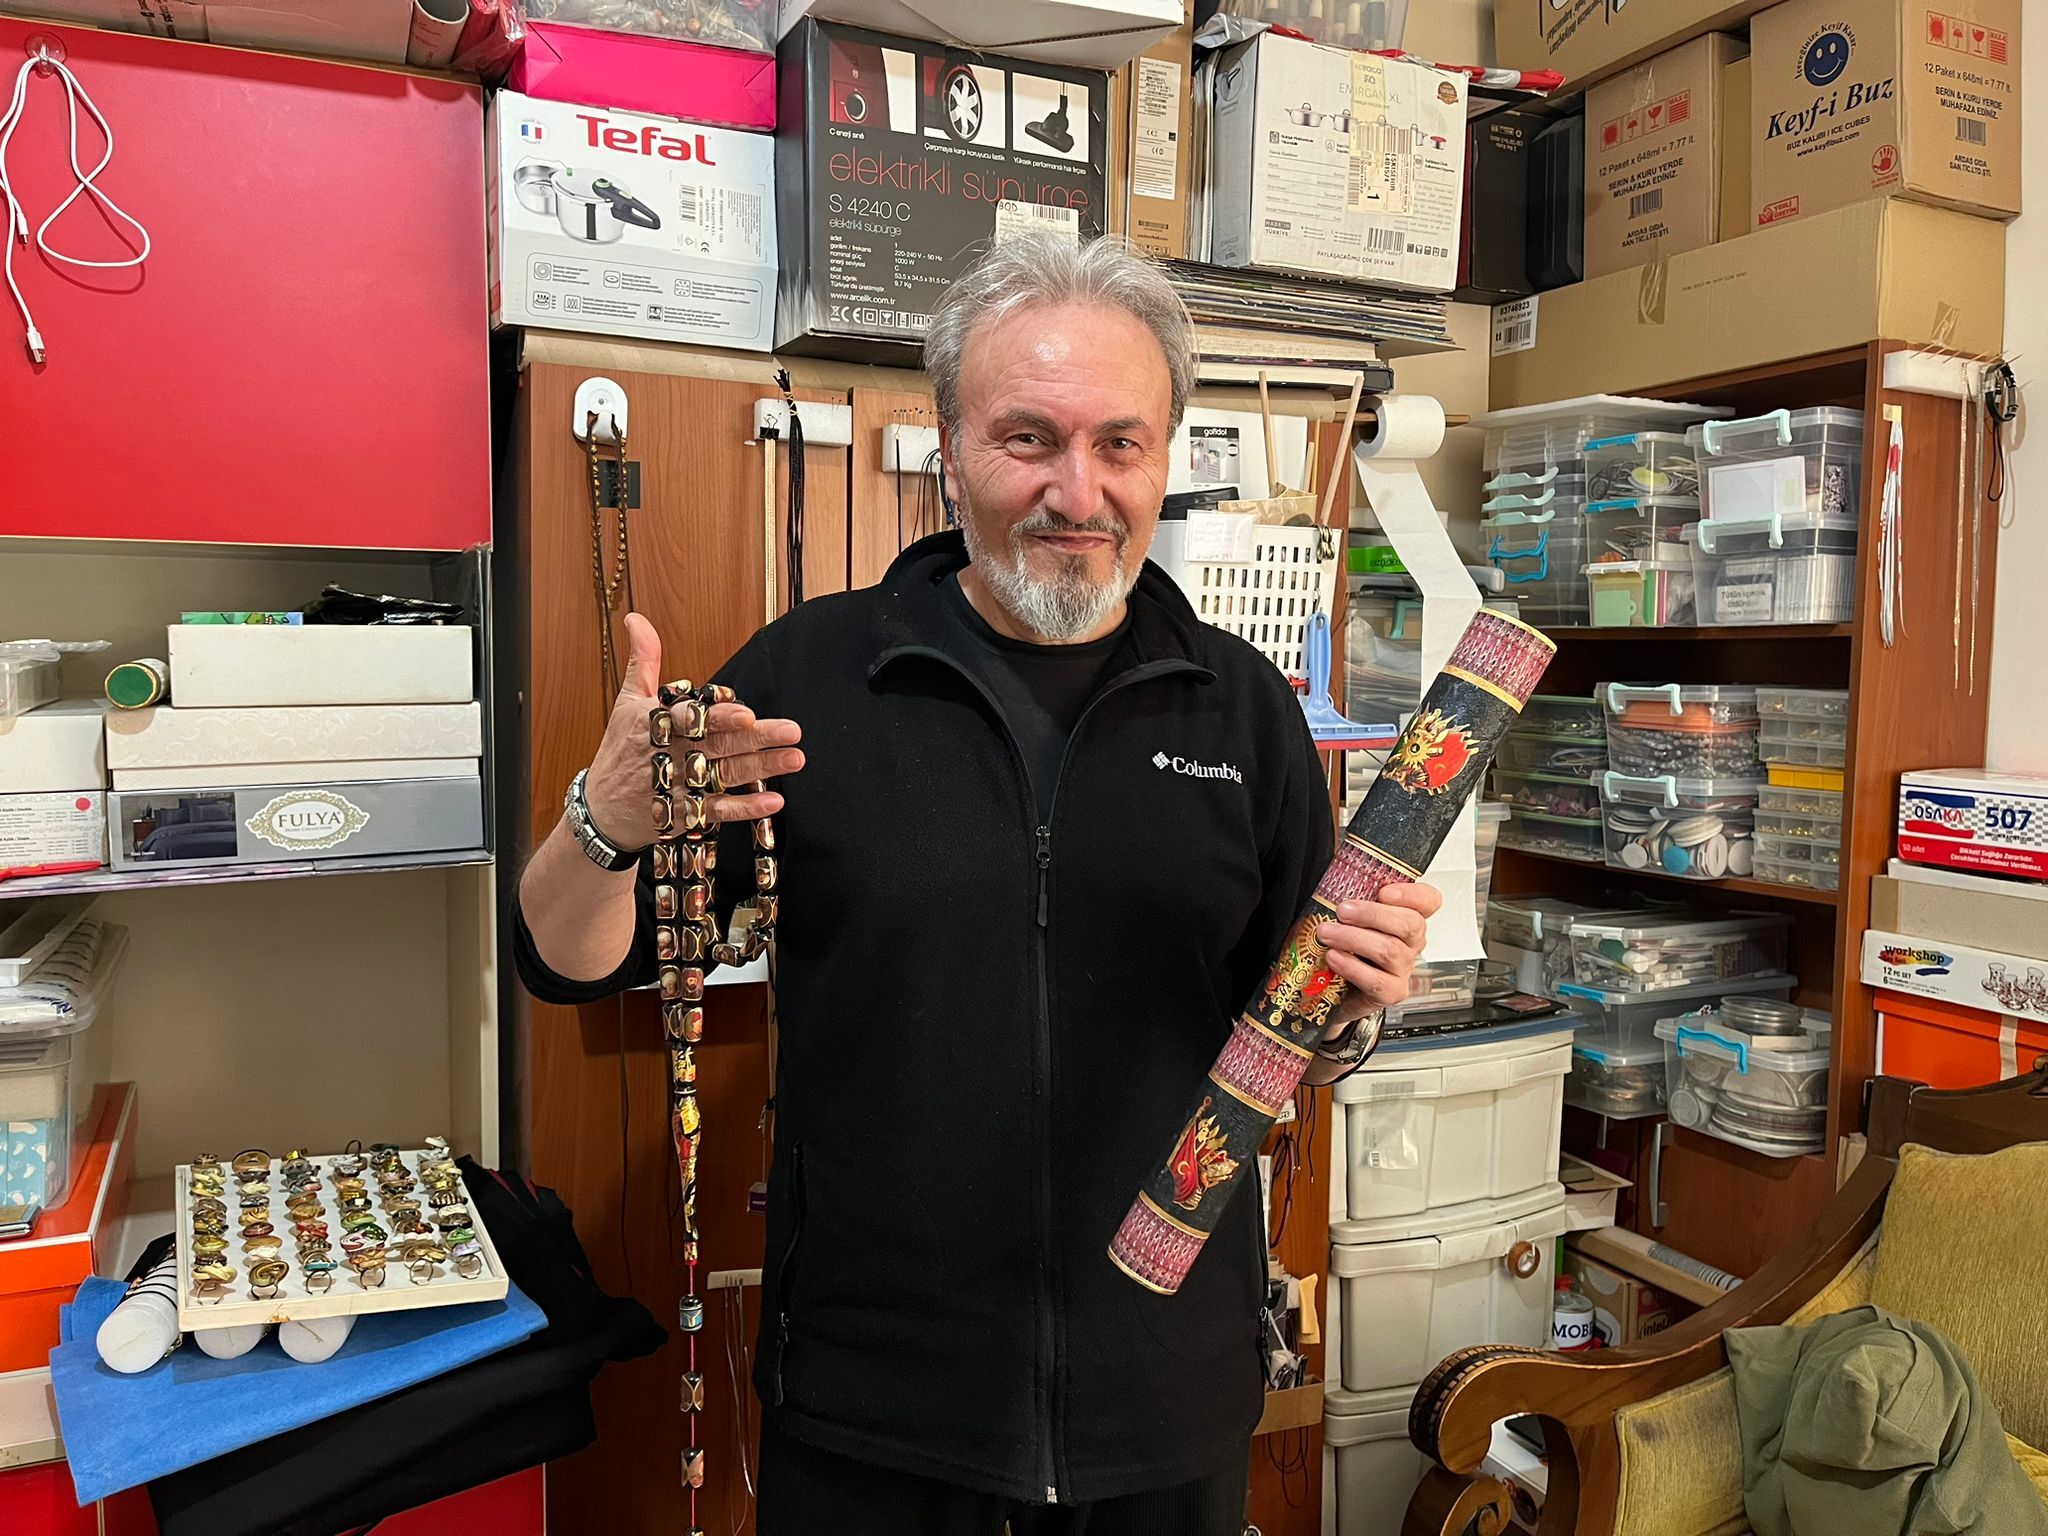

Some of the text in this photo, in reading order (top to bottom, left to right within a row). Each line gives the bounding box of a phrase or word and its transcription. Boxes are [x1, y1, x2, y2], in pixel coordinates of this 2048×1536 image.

[1820, 21, 1844, 34] Keyif
[1924, 62, 1933, 73] 12
[1935, 65, 1956, 78] Paket
[1962, 71, 1983, 85] 648ml
[1389, 92, 1402, 104] XL
[1935, 85, 2003, 111] SERİN & KURU YERDE
[1940, 98, 1976, 114] MUHAFAZA
[1764, 78, 1894, 140] Keyf-i Buz
[576, 114, 716, 166] Tefal
[1786, 140, 1801, 151] BUZ
[1831, 125, 1843, 136] ICE
[1844, 115, 1871, 131] CUBES
[924, 142, 953, 153] Çarpmaya
[967, 149, 991, 160] koruyucu
[1013, 156, 1032, 167] Yüksek
[1599, 167, 1607, 177] 12
[1608, 160, 1629, 174] Paket
[1630, 158, 1636, 166] x
[1636, 150, 1660, 163] 648ml
[829, 146, 950, 194] elektrikli
[1608, 157, 1684, 191] SERİN & KURU YERDE
[1613, 182, 1651, 198] MUHAFAZA
[829, 193, 911, 221] S 4240 C
[829, 218, 902, 237] elektrikli süpürge
[1265, 219, 1283, 228] MADE
[829, 250, 851, 258] nominal
[852, 252, 862, 260] güç
[852, 245, 872, 253] frekans
[894, 250, 917, 258] 220-240
[829, 258, 844, 267] enerji
[845, 260, 866, 268] seviyesi
[1384, 258, 1395, 266] VAR
[830, 281, 858, 290] Türkiye'de
[830, 292, 896, 305] www.arcelik.com.tr
[1172, 756, 1243, 784] Columbia
[278, 811, 341, 828] FULYA
[1914, 805, 2032, 831] OSAKA 507
[1902, 843, 1925, 854] 50 adet
[1959, 846, 1980, 856] Dikkat!
[1981, 849, 2003, 860] Sağlığa
[1950, 853, 2043, 872] Çocuklara Satılamaz Verilemez.
[1883, 966, 1892, 975] 12
[1883, 976, 1888, 984] 6
